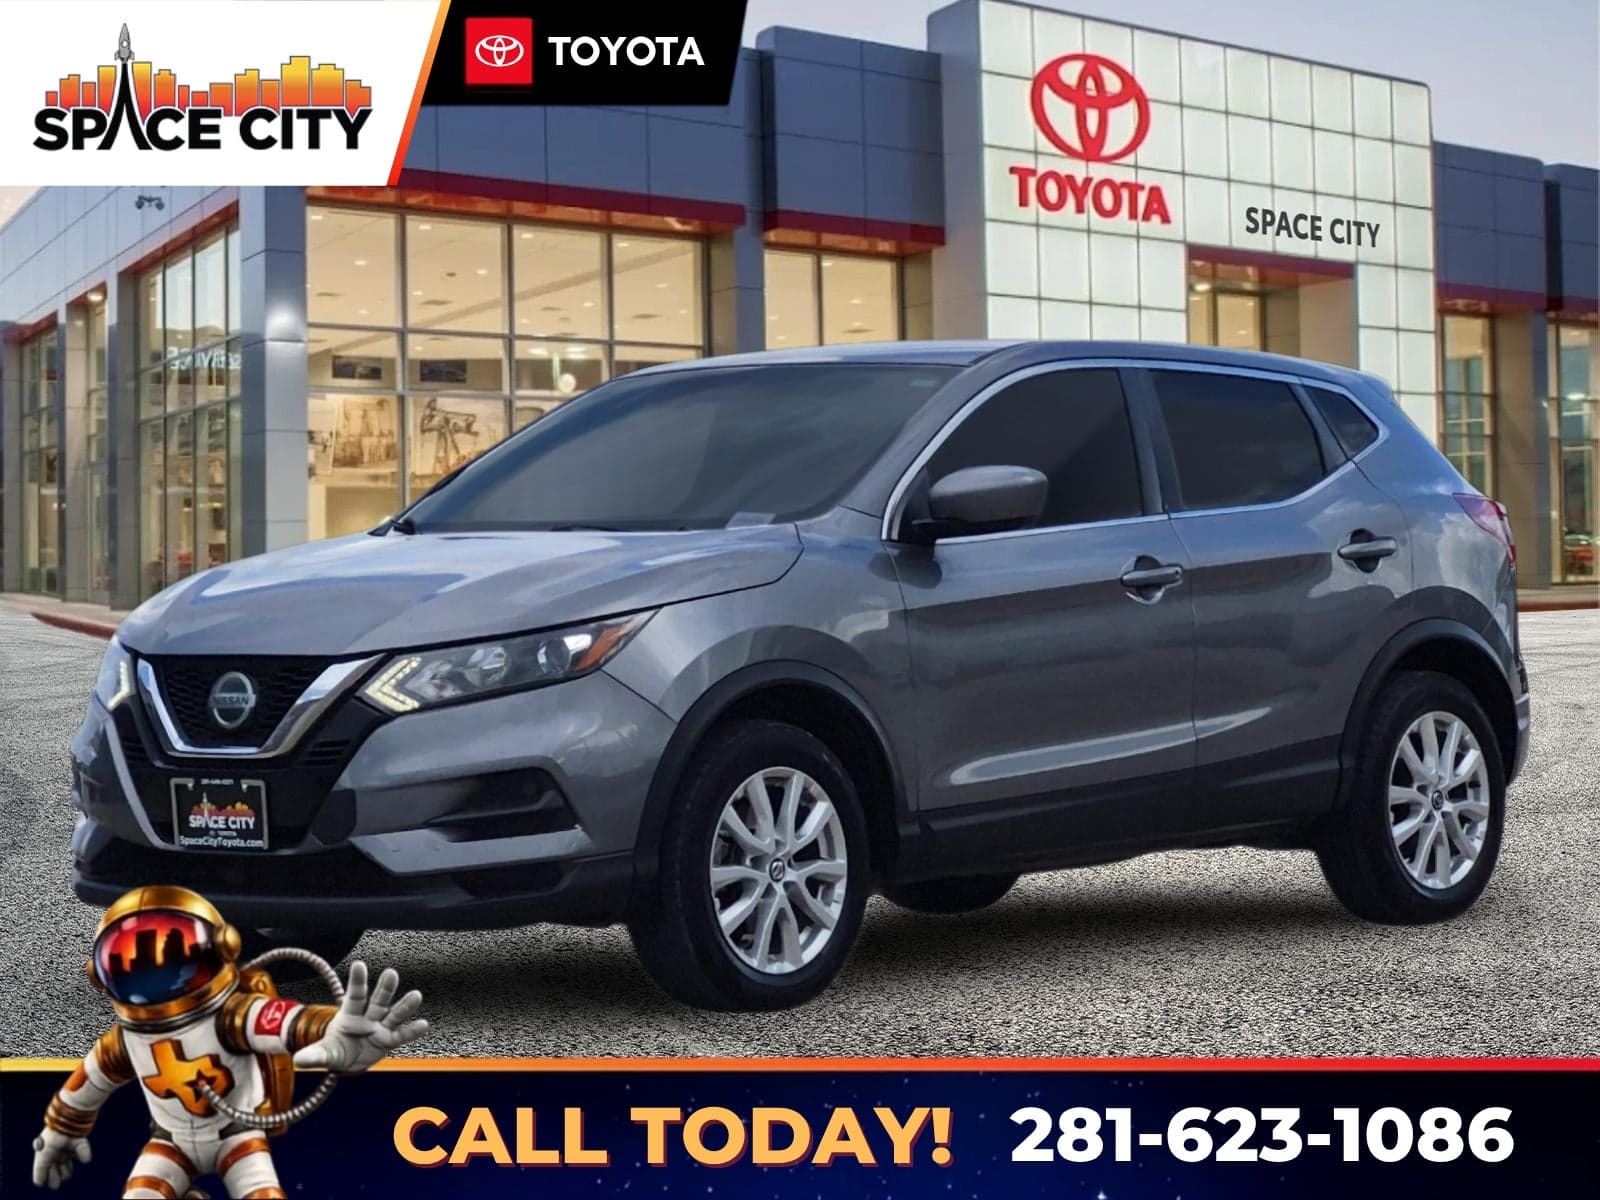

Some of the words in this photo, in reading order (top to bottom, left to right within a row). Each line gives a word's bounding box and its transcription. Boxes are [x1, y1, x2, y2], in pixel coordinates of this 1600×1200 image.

[1009, 166, 1171, 224] TOYOTA
[1245, 206, 1323, 242] SPACE
[1329, 217, 1381, 248] CITY
[188, 814, 226, 829] SPACE
[227, 816, 256, 830] CITY
[179, 834, 265, 848] SpaceCityToyota.com
